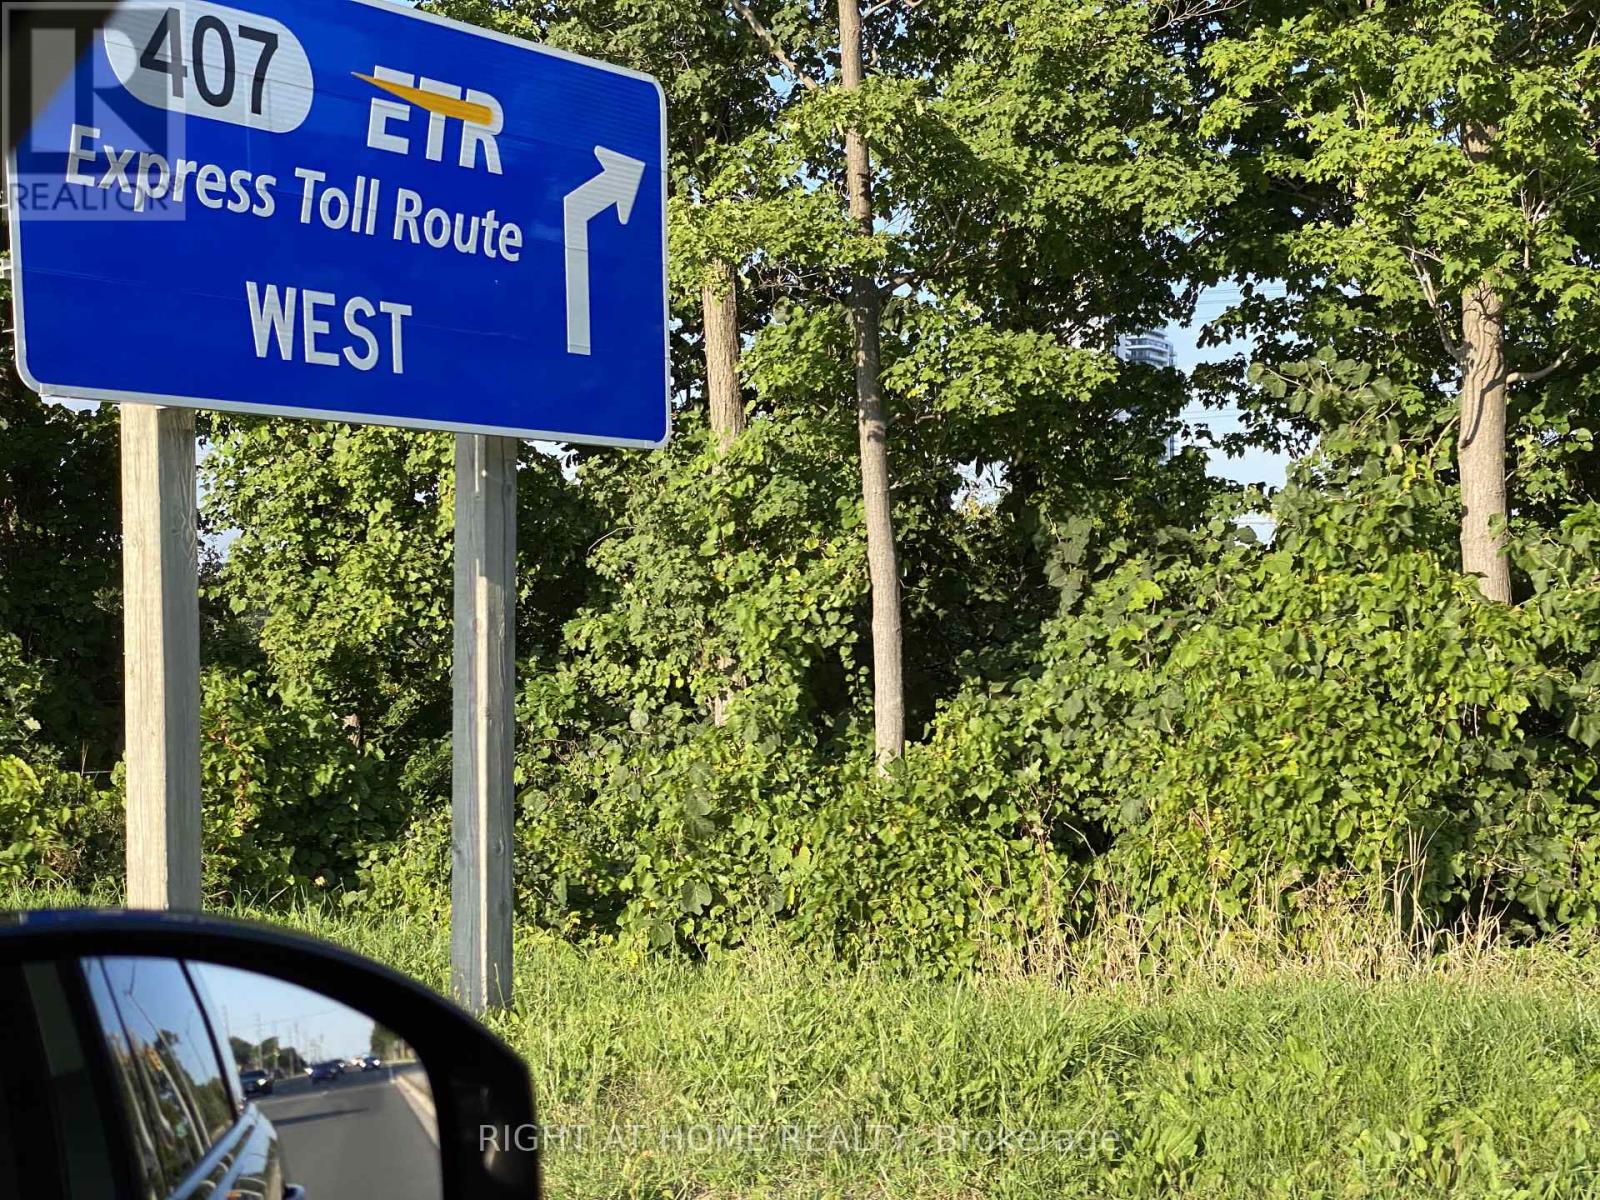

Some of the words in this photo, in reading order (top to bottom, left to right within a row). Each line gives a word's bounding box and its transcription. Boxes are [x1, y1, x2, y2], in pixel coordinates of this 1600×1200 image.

[139, 7, 279, 115] 407
[366, 65, 504, 175] ETR
[65, 123, 277, 218] Express
[294, 167, 379, 236] Toll
[394, 188, 523, 262] Route
[246, 281, 412, 374] WEST
